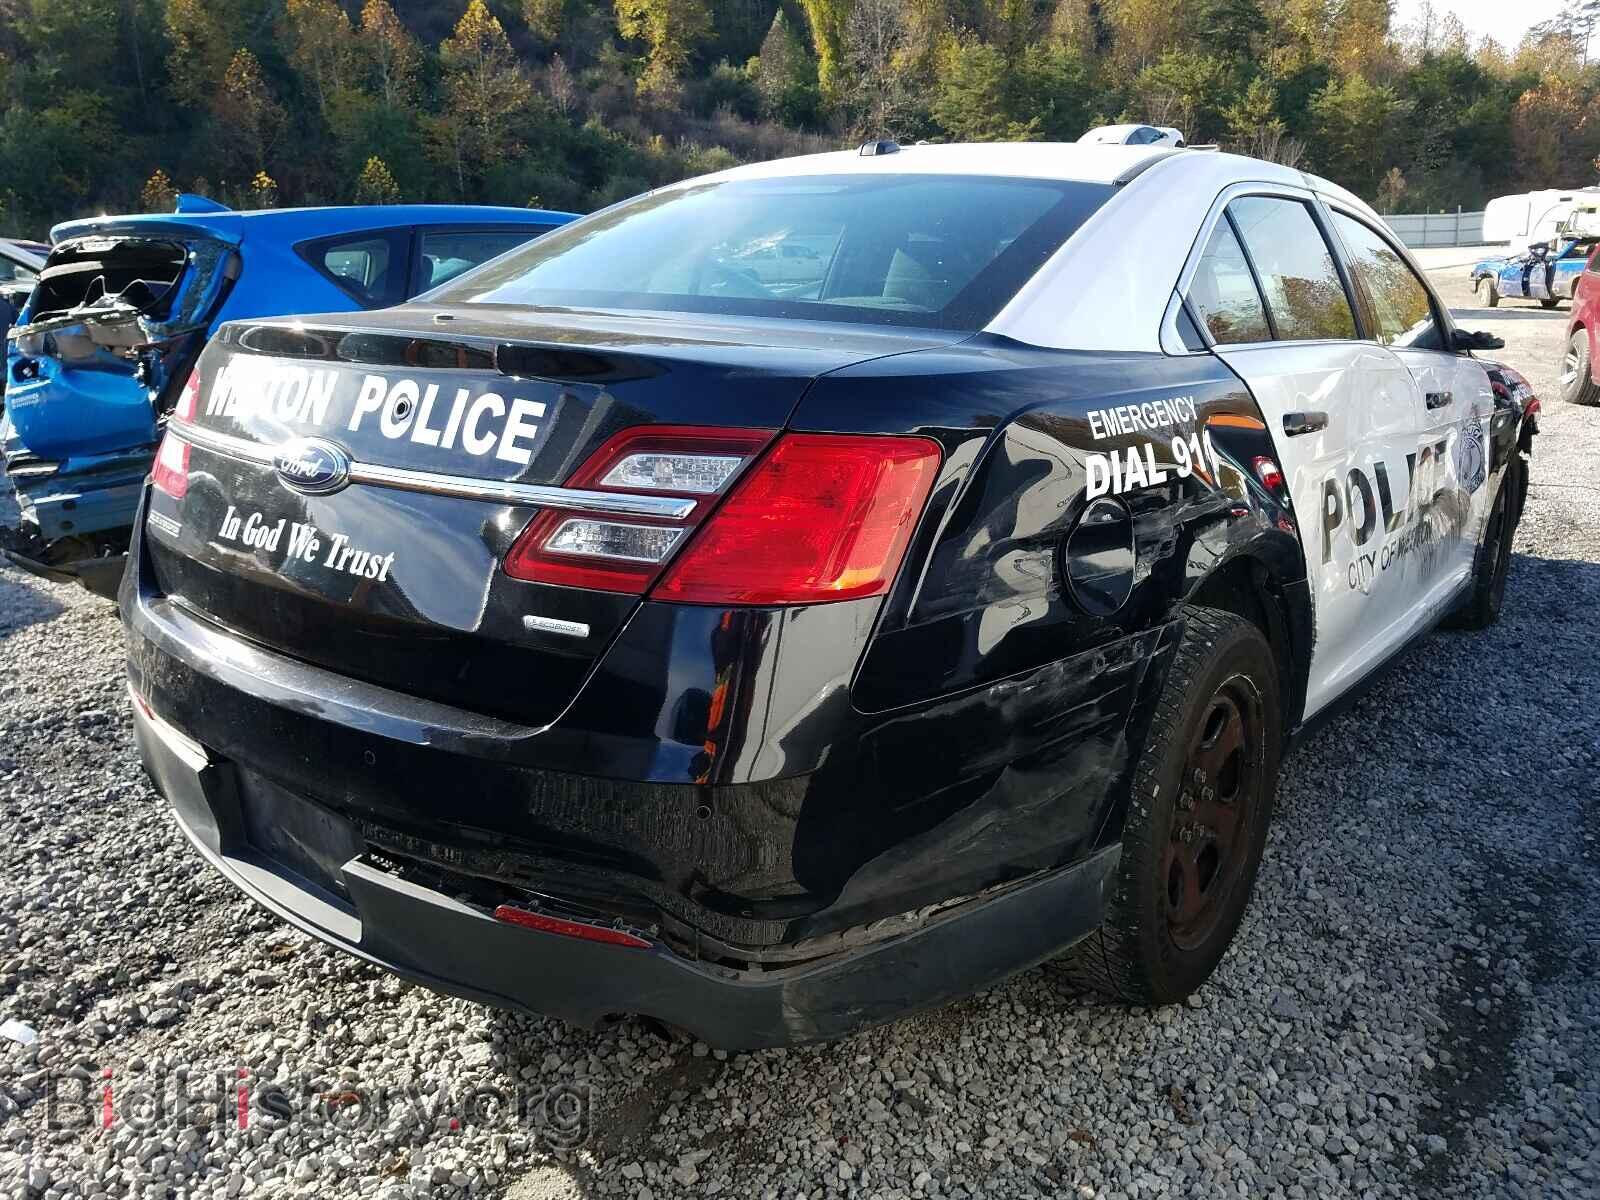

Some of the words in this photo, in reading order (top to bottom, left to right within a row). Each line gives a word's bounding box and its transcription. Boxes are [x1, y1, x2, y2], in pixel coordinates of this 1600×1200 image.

[206, 366, 339, 425] WTON
[348, 375, 546, 465] POLICE
[1087, 396, 1197, 440] EMERGENCY
[1086, 443, 1167, 501] DIAL
[1171, 432, 1221, 488] 911
[1321, 439, 1448, 566] POL
[218, 505, 242, 541] In
[242, 511, 287, 552] God
[287, 521, 320, 562] We
[323, 533, 395, 582] Trust
[1348, 550, 1376, 590] CITY
[1380, 540, 1397, 571] OF
